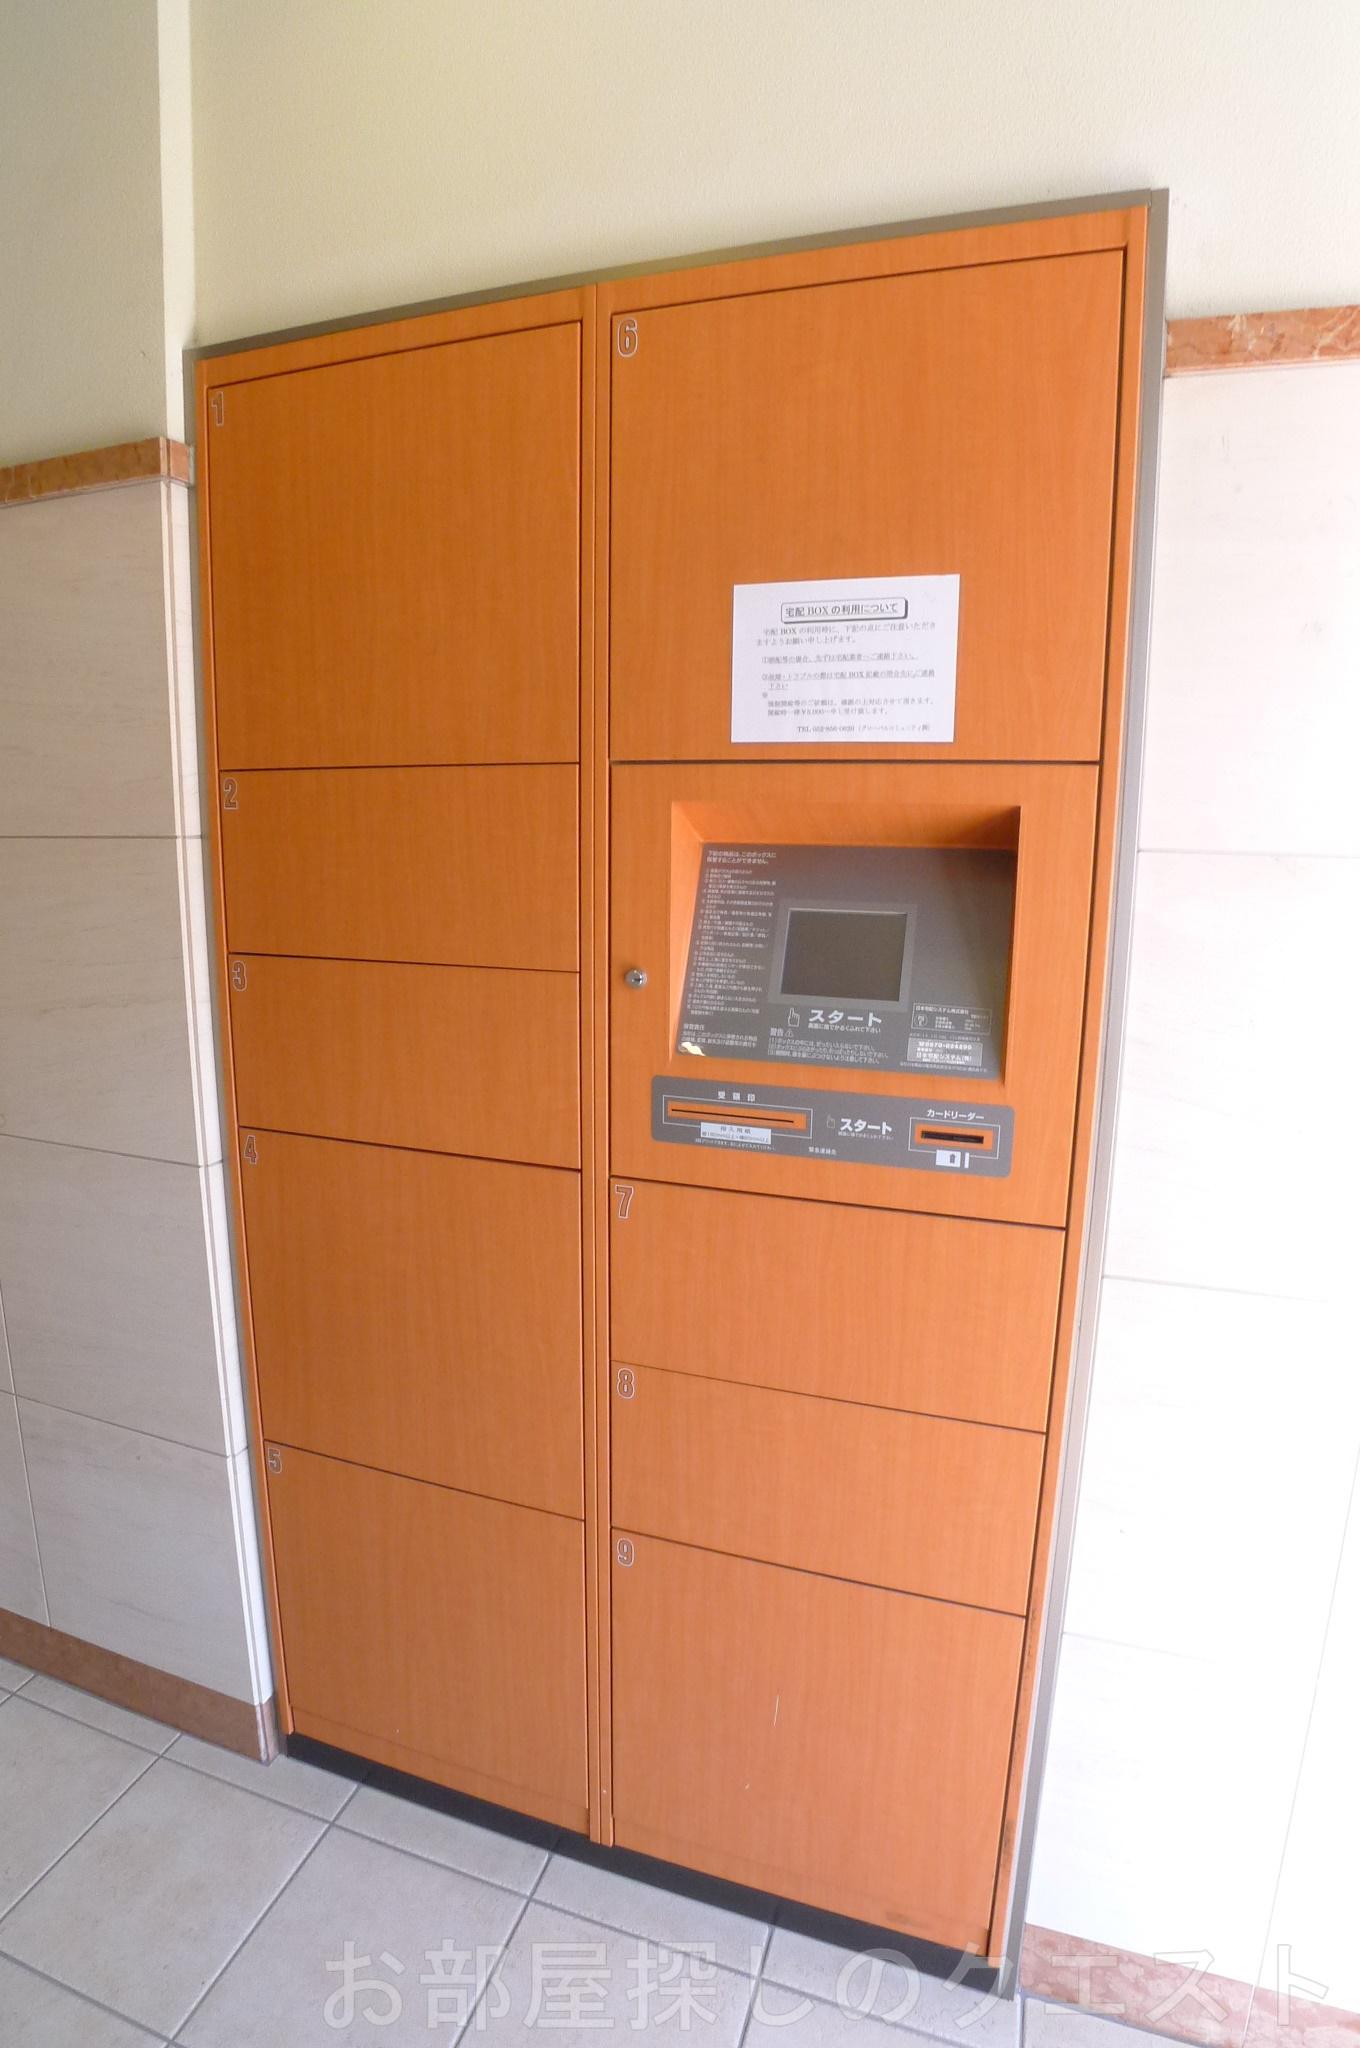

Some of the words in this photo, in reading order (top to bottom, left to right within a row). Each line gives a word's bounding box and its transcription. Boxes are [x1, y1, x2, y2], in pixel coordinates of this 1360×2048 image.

[617, 318, 639, 358] 6
[212, 391, 225, 426] 1
[223, 777, 239, 810] 2
[232, 960, 248, 992] 3
[808, 1009, 882, 1027] スタート
[840, 1117, 893, 1135] スタート
[926, 1108, 985, 1120] カードリーダー
[243, 1134, 259, 1165] 4
[615, 1184, 634, 1220] 7
[616, 1367, 636, 1399] 8
[267, 1446, 283, 1474] 5
[617, 1537, 635, 1568] 9
